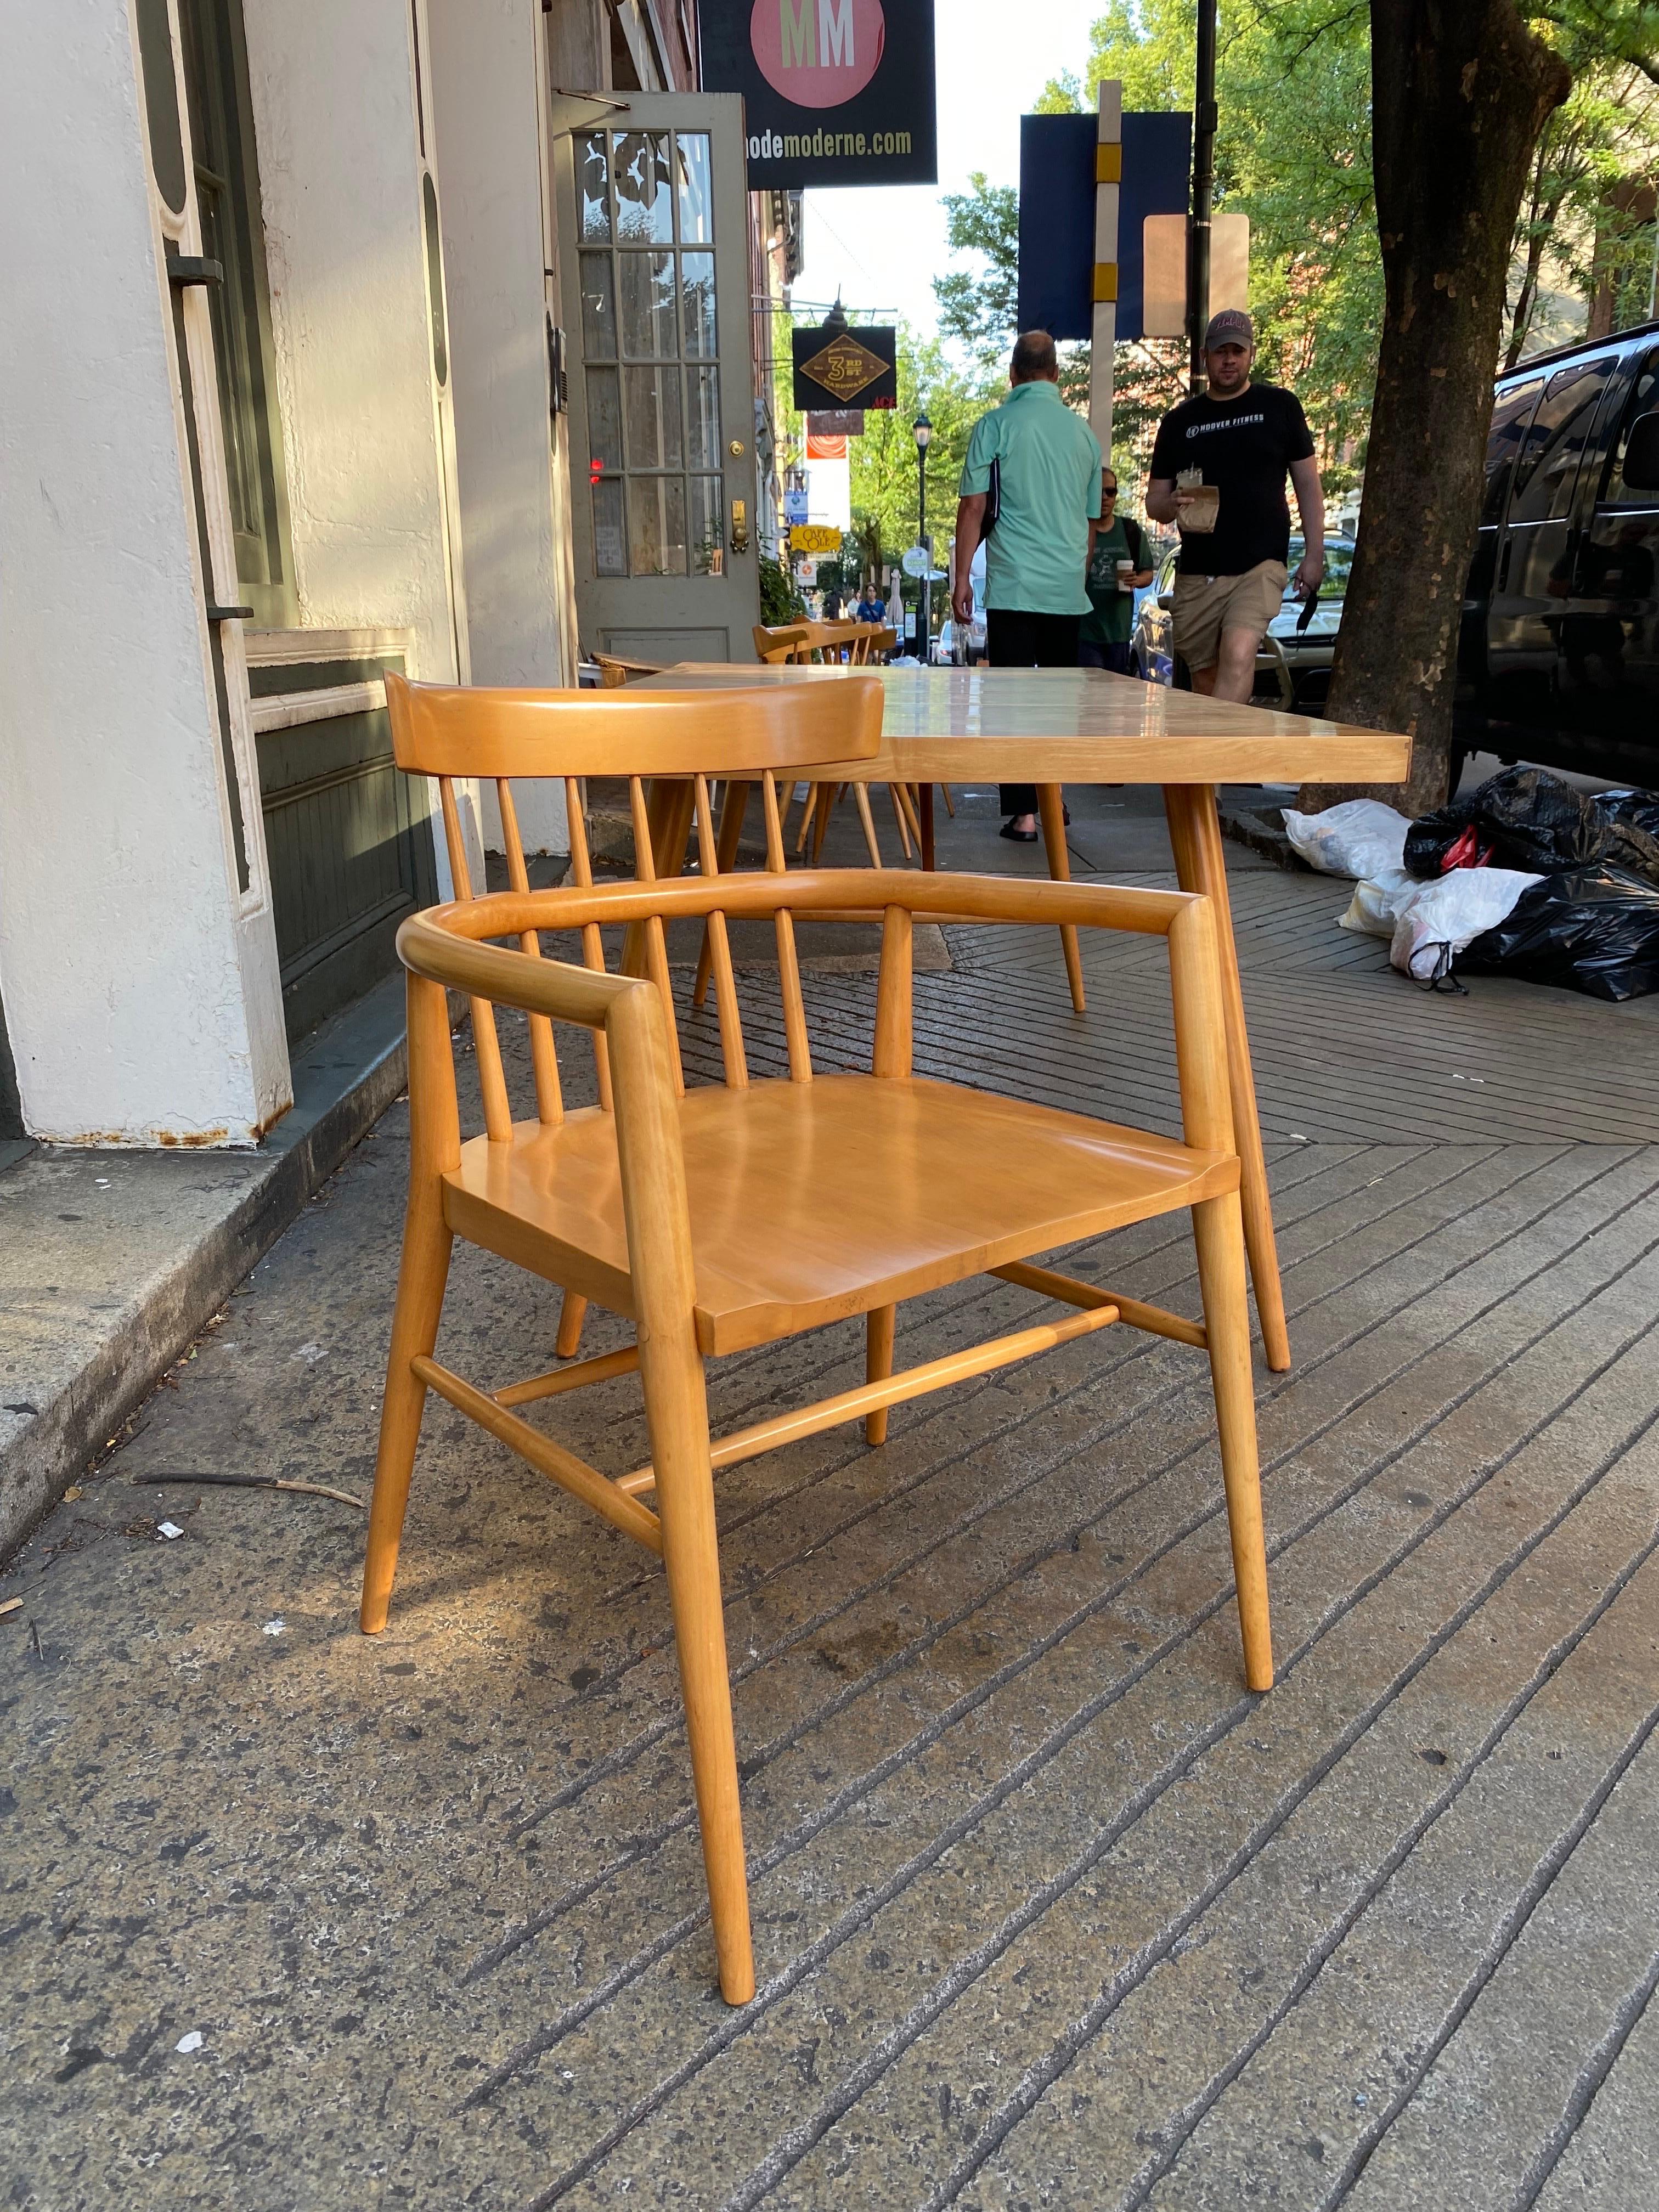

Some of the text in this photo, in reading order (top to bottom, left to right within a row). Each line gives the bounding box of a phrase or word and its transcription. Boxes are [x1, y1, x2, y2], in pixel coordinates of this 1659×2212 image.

[779, 0, 854, 68] MM
[828, 357, 844, 381] 3
[823, 376, 869, 389] HARDWARE
[872, 396, 896, 408] ACE
[1200, 414, 1264, 431] HOOVER FITNESS
[803, 529, 827, 541] CAFE
[808, 538, 830, 550] OLE
